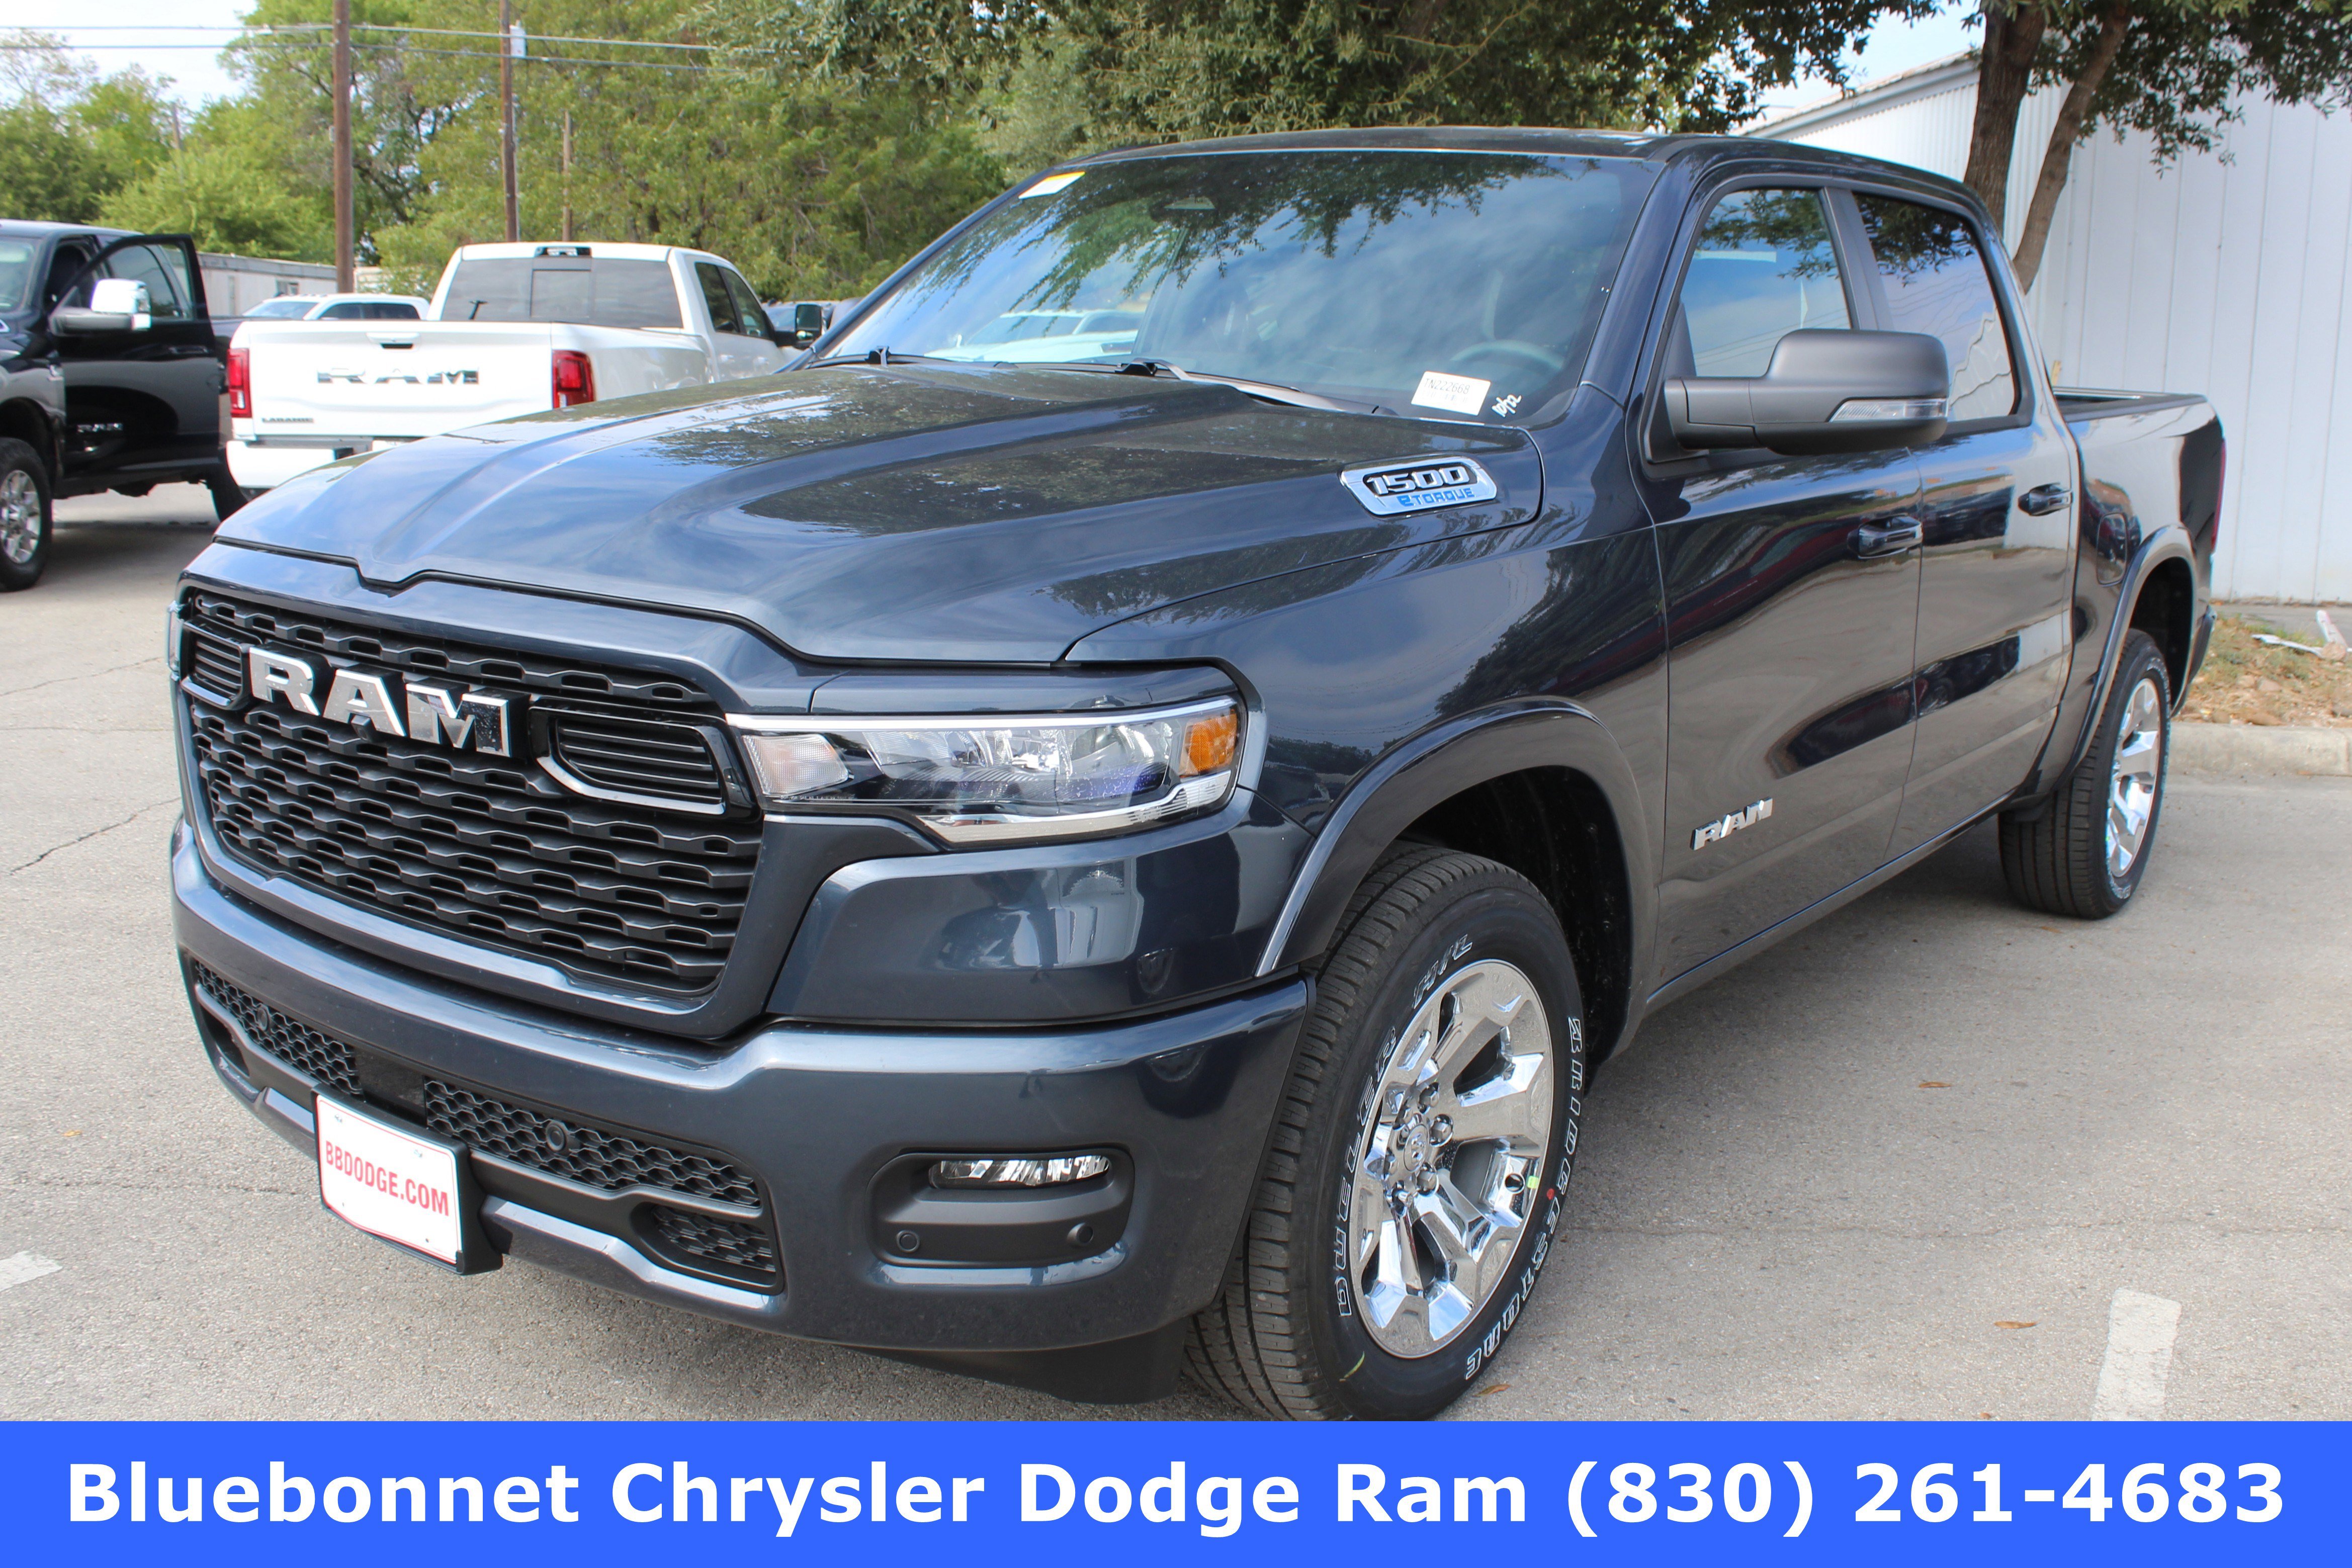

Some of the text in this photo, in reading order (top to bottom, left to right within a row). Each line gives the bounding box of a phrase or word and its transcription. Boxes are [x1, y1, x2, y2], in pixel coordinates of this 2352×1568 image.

[317, 366, 479, 384] RAM
[1423, 378, 1471, 395] TN222668
[1367, 466, 1470, 495] 1500
[249, 647, 510, 758] RAM
[1691, 798, 1773, 850] RAM
[325, 1140, 449, 1216] BBDODGE.COM
